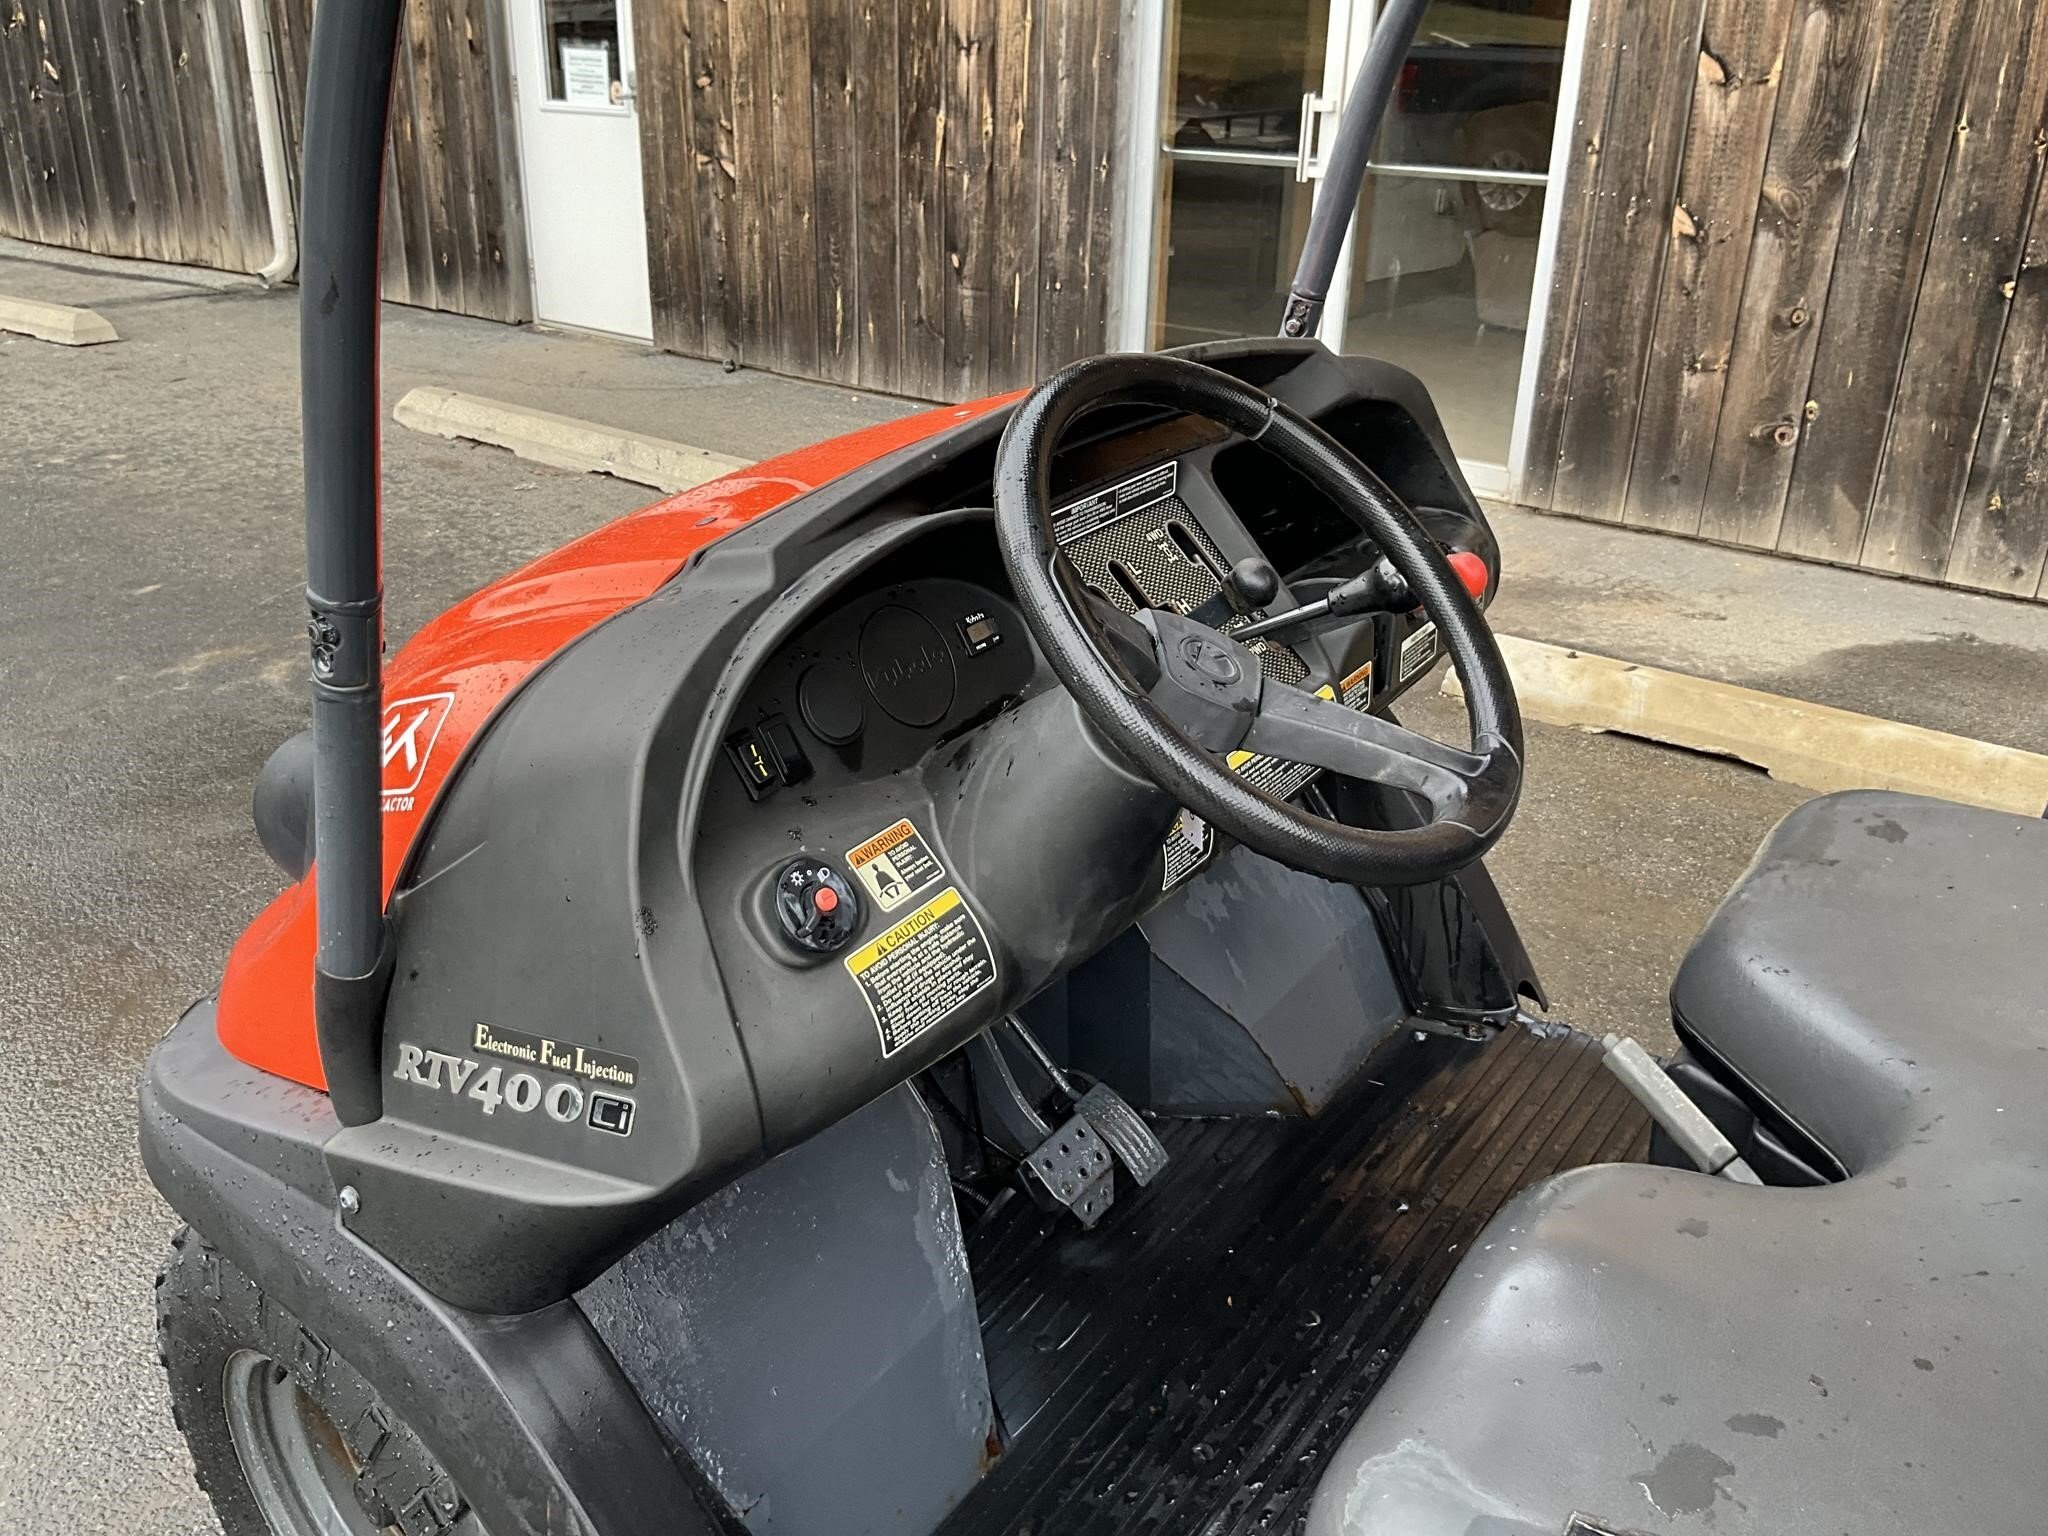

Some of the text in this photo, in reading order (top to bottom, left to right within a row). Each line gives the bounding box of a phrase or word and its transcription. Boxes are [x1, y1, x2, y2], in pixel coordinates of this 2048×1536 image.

[1146, 528, 1164, 542] 4WD
[1126, 562, 1142, 576] L
[1175, 599, 1192, 614] H
[383, 796, 414, 812] ACTOR
[860, 823, 911, 859] WARNING
[894, 840, 909, 853] AVOID
[870, 967, 889, 983] Before
[910, 945, 920, 955] the
[939, 921, 953, 934] make
[953, 913, 966, 924] sure
[884, 908, 935, 948] CAUTION
[860, 921, 939, 980] TO AVOID PERSONAL INJURY:
[874, 977, 886, 989] that
[927, 939, 939, 951] safe
[877, 982, 891, 994] from
[890, 974, 900, 984] the
[920, 953, 931, 964] and
[931, 946, 940, 956] the
[892, 990, 902, 1000] not
[923, 968, 932, 977] the
[951, 943, 966, 957] under
[967, 936, 975, 945] the
[880, 986, 897, 1001] outlet
[903, 974, 912, 984] off
[888, 1005, 902, 1018] Keep
[936, 969, 951, 983] place
[952, 961, 962, 972] and
[962, 953, 974, 964] stay
[918, 974, 934, 989] drugs
[475, 1024, 634, 1084] Electronic Fuel Injection
[394, 1042, 584, 1122] RTV400
